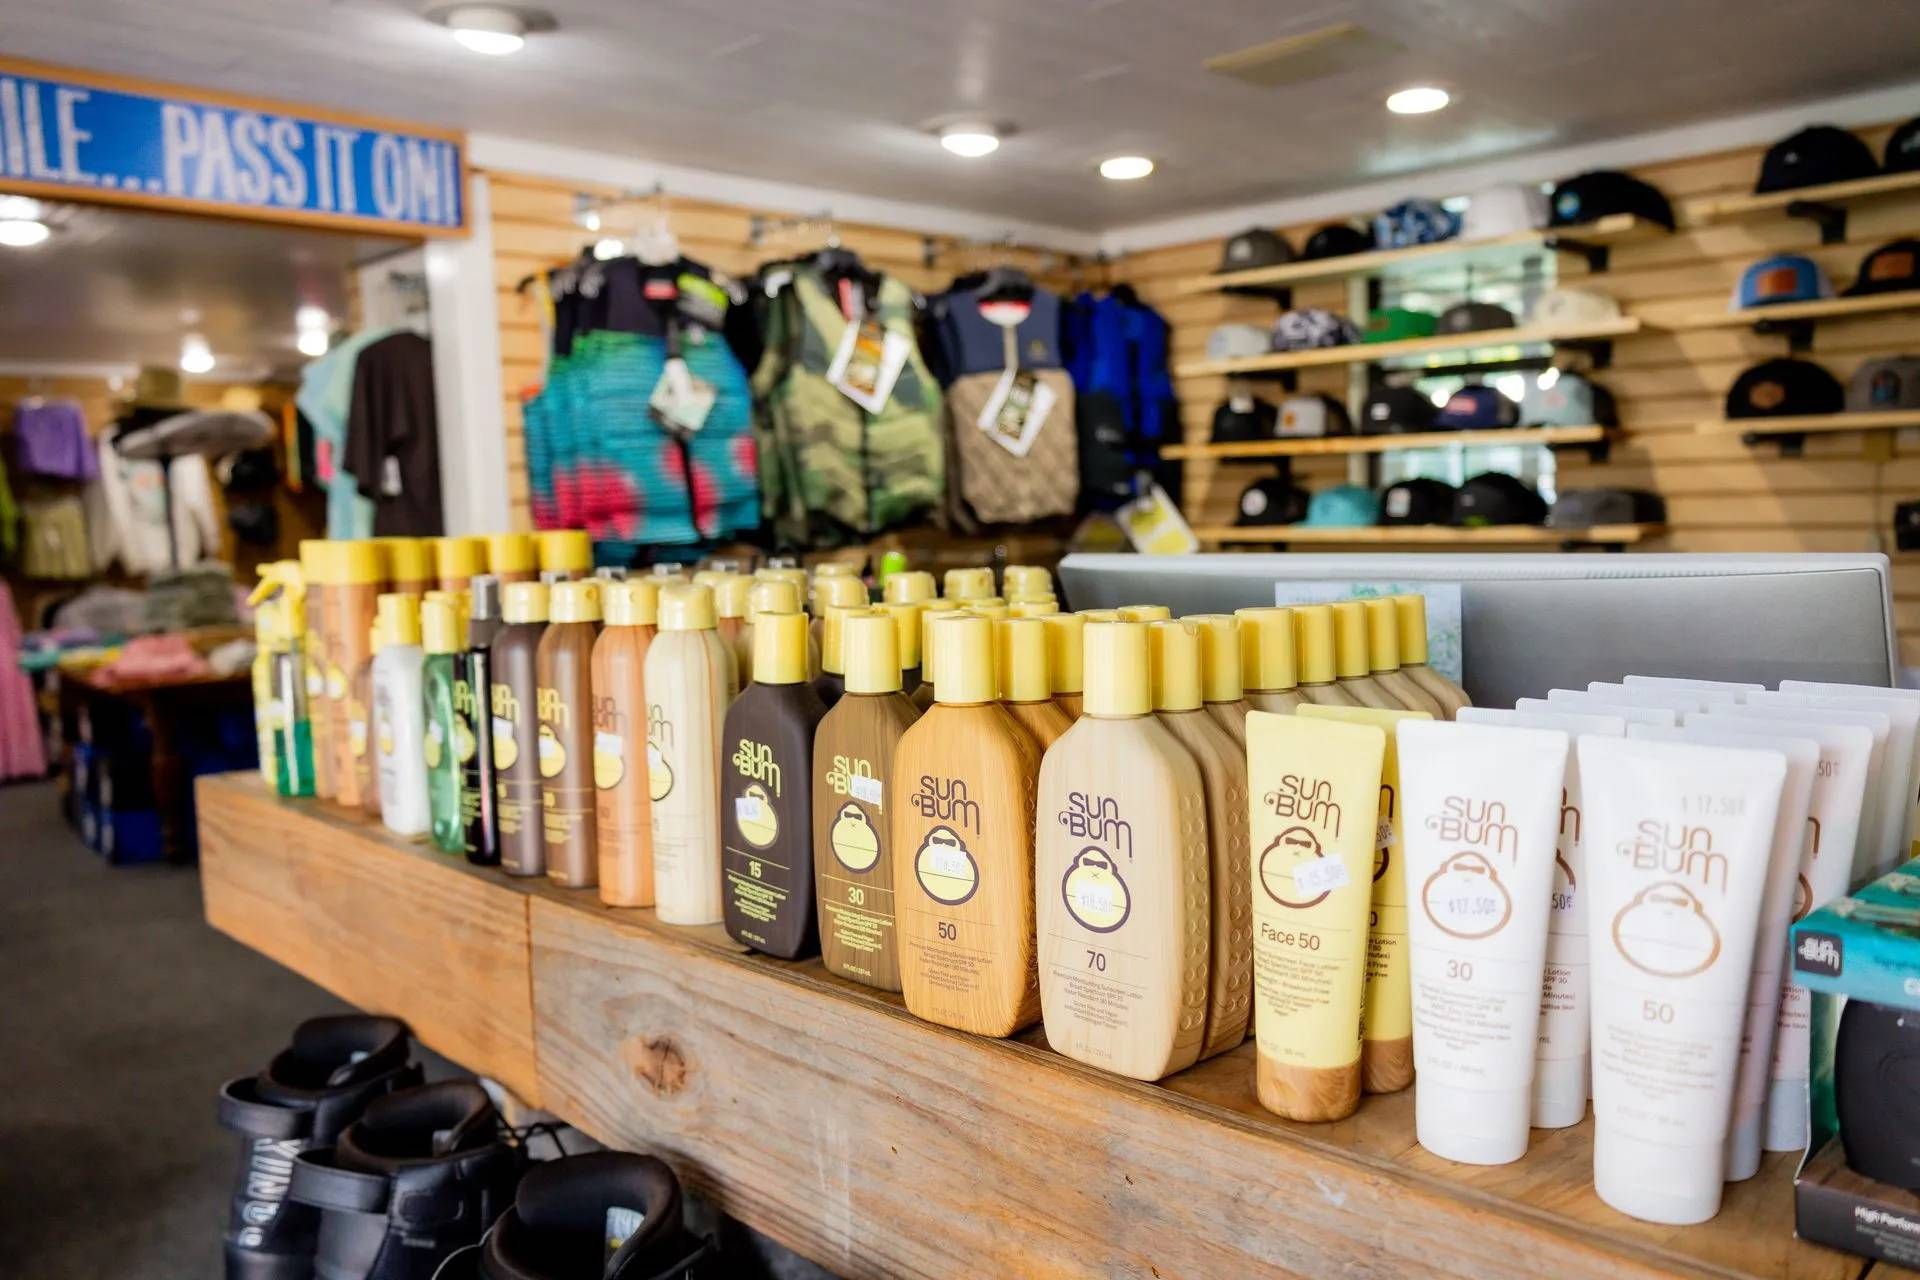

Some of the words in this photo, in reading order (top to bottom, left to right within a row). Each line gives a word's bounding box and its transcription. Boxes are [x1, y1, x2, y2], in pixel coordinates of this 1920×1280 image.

[313, 126, 362, 213] IT
[370, 133, 461, 227] ON!
[748, 860, 762, 880] 15
[847, 885, 865, 906] 30
[937, 921, 957, 941] 50
[1261, 921, 1295, 946] Face
[1298, 931, 1321, 951] 50
[1086, 949, 1106, 972] 70
[1447, 959, 1473, 982] 30
[1642, 999, 1675, 1025] 50
